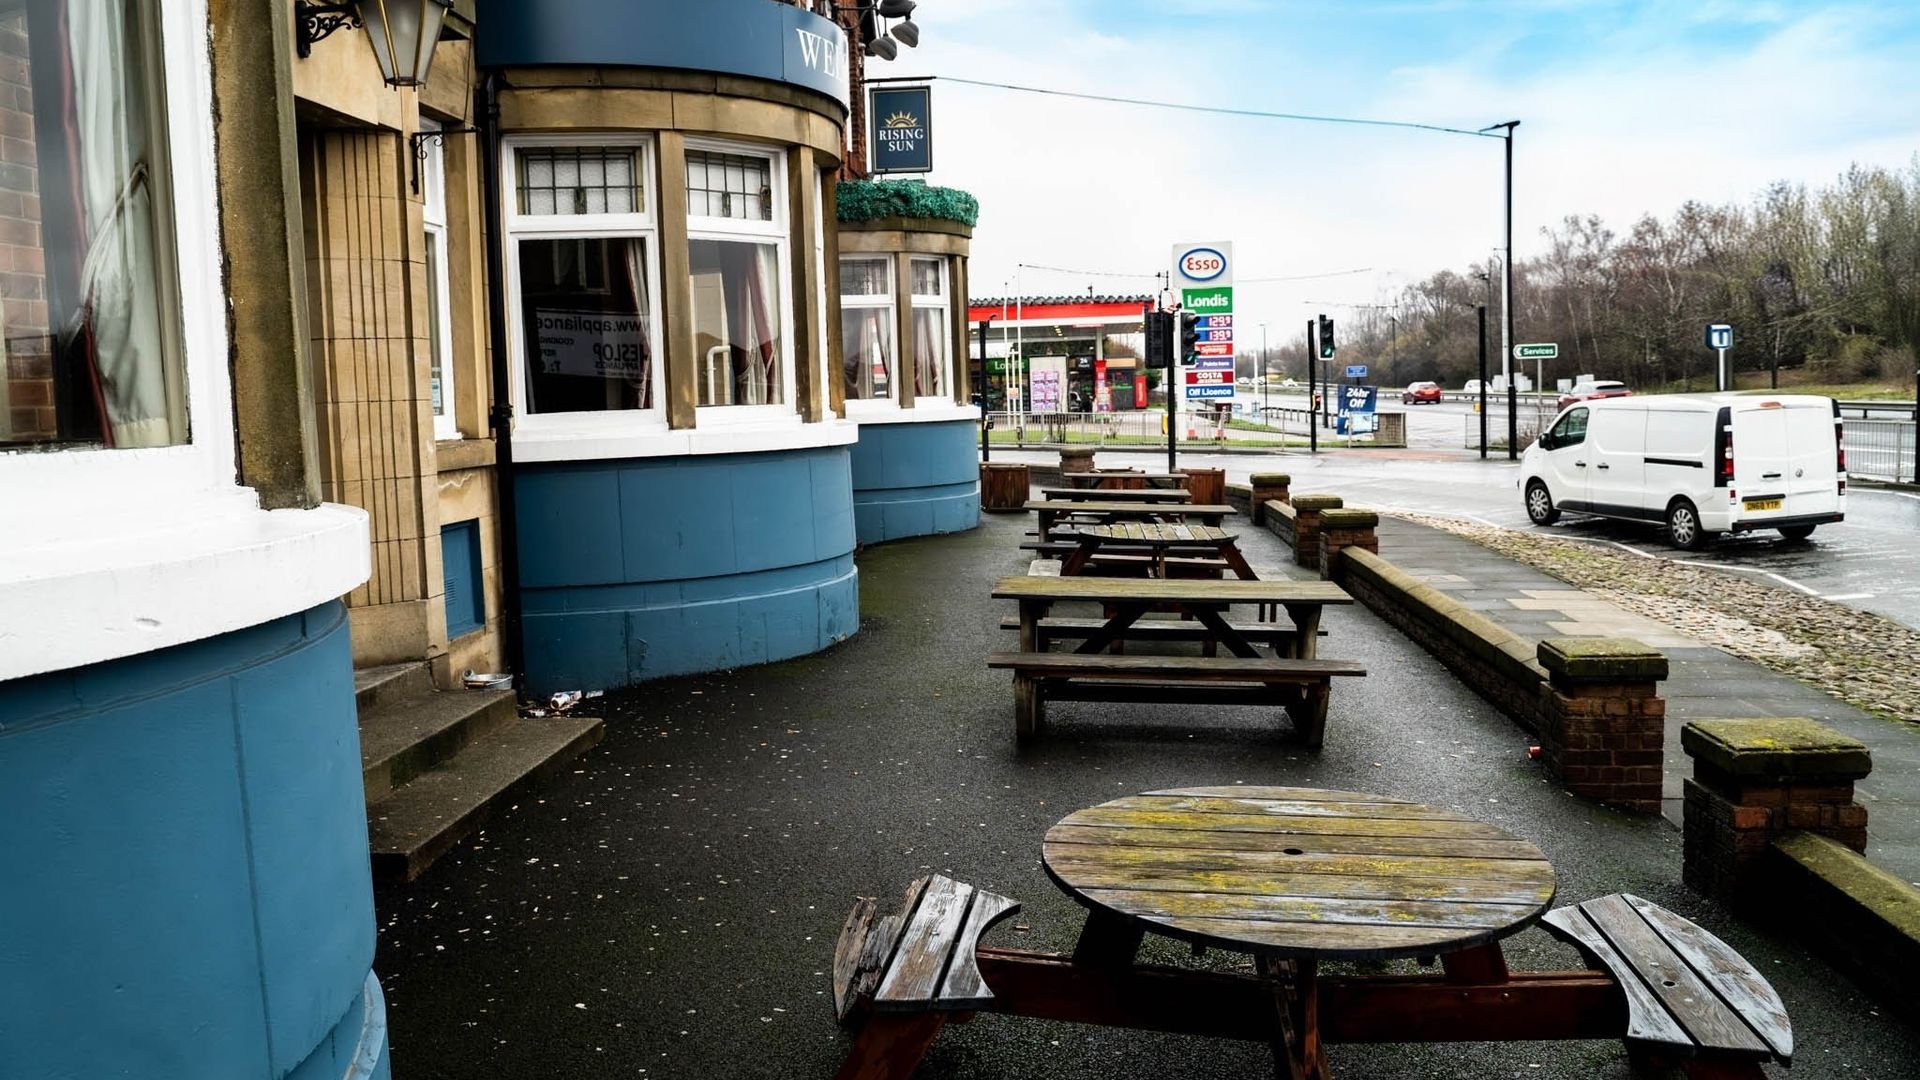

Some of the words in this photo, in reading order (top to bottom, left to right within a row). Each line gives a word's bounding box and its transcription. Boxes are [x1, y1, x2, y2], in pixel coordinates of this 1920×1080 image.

[879, 128, 924, 141] RISING
[888, 141, 915, 152] SUN
[1186, 256, 1219, 271] Esso
[1187, 294, 1229, 308] Londis
[1523, 347, 1554, 356] Services
[1188, 388, 1201, 397] Off
[1202, 388, 1232, 396] Licence
[1346, 387, 1370, 398] 24hr
[1349, 399, 1366, 408] Off
